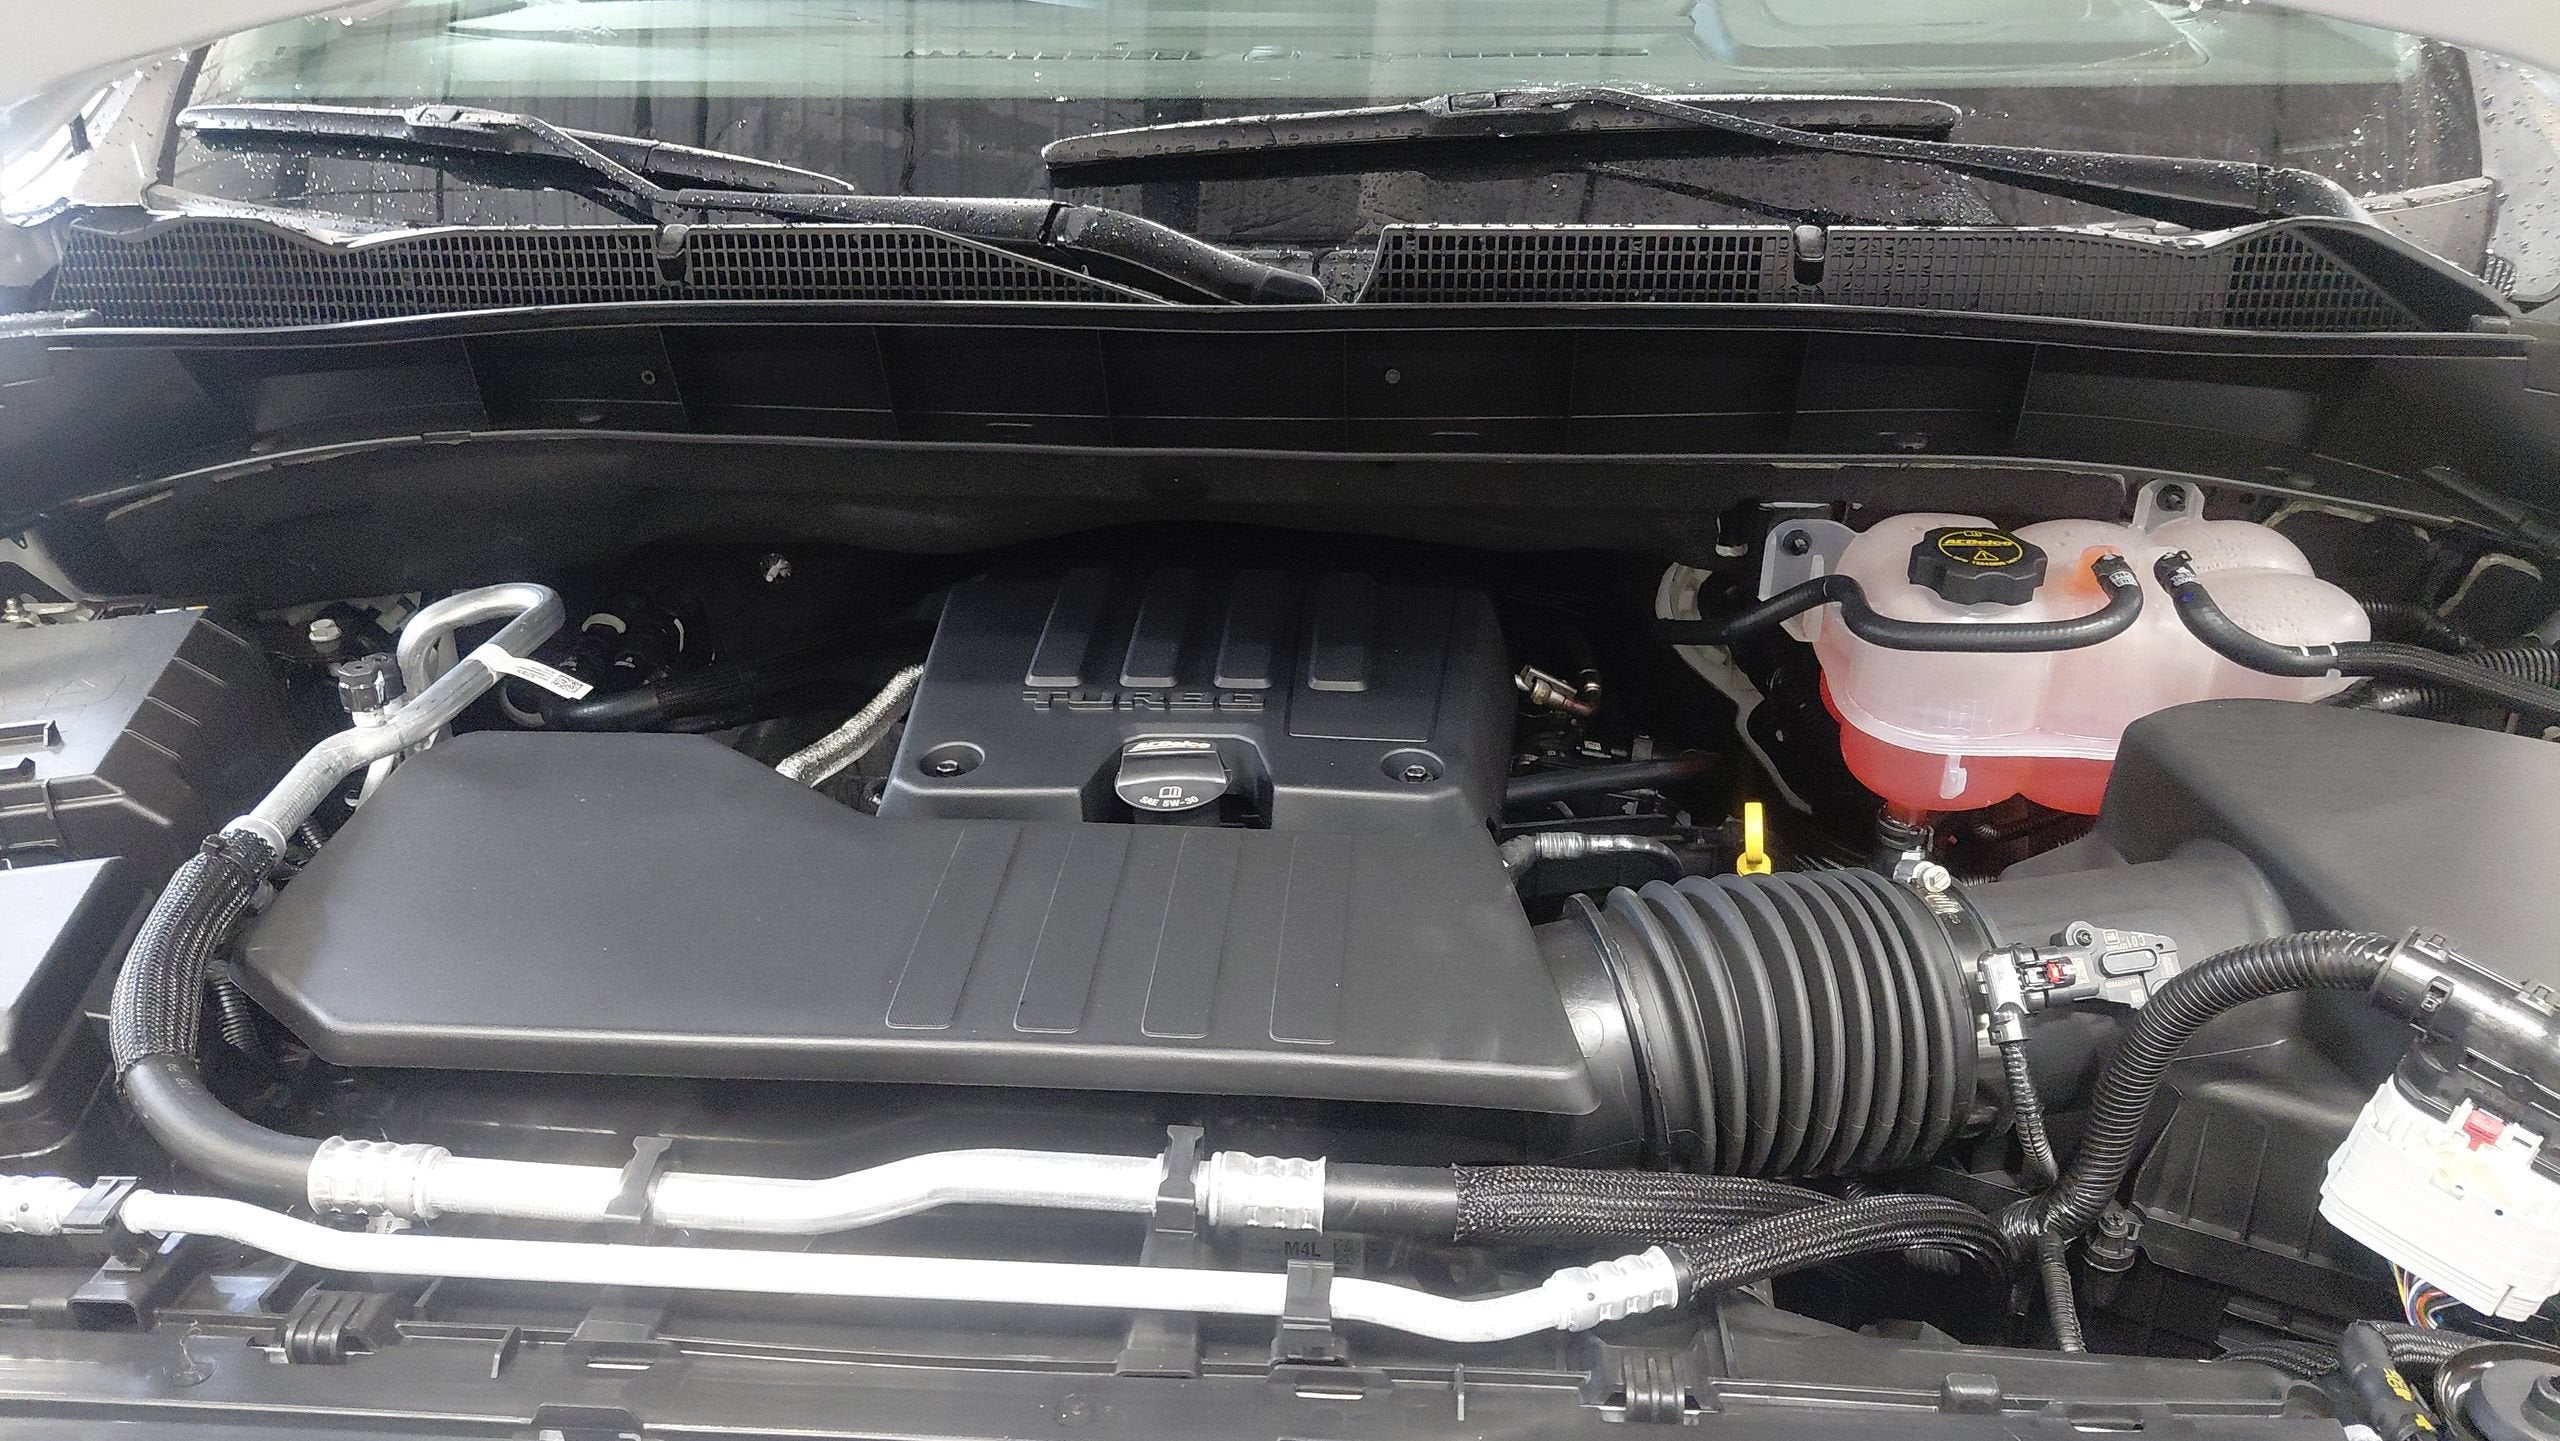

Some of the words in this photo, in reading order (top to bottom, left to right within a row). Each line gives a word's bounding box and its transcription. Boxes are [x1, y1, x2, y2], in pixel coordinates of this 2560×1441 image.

[1942, 539, 2014, 547] ACDelco
[1022, 691, 1265, 712] TURBO
[1128, 740, 1211, 753] ACDelco
[1139, 796, 1159, 807] SAE
[1162, 796, 1199, 808] 5W-30
[1284, 1241, 1321, 1258] M4L
